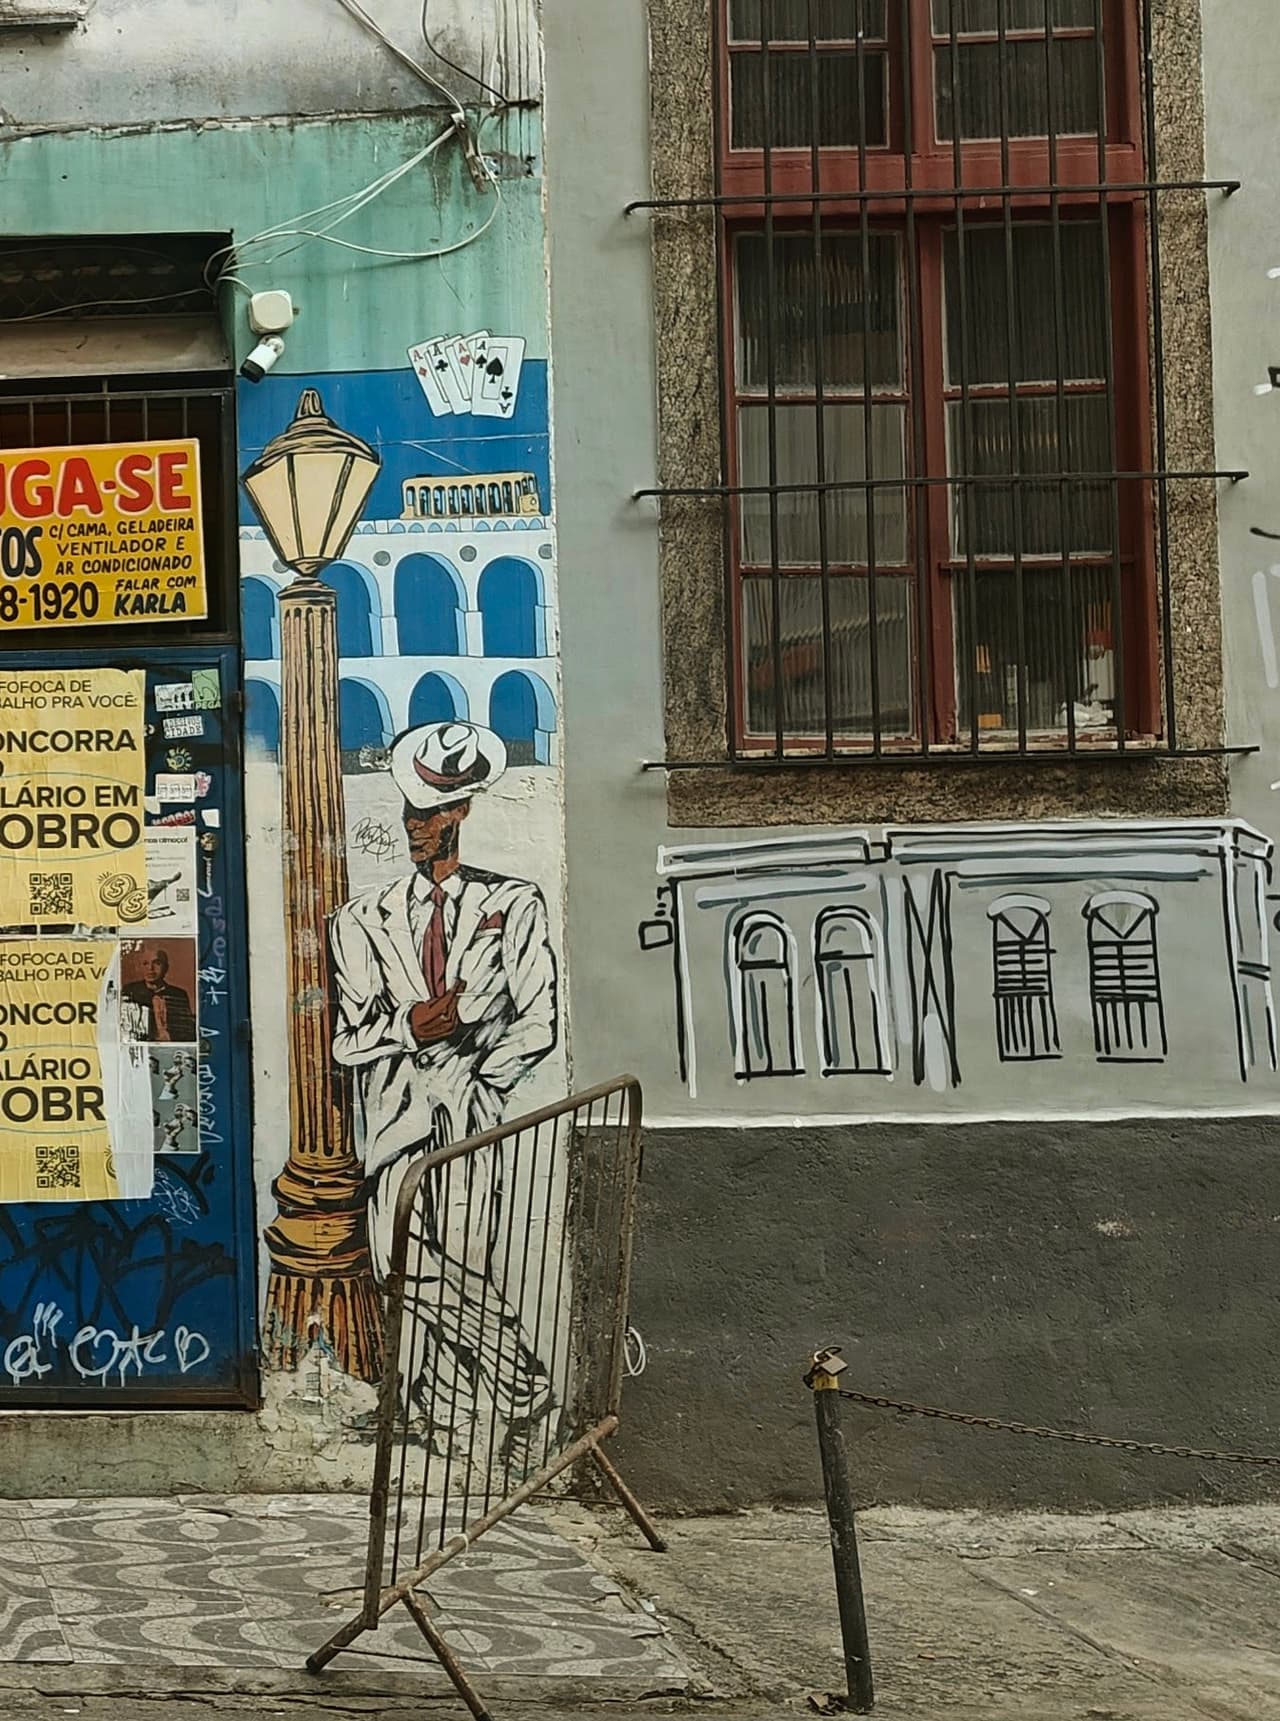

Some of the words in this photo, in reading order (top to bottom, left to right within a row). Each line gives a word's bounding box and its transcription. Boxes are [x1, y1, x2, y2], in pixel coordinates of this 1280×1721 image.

[49, 523, 64, 540] C/
[67, 523, 112, 538] CAMA,
[117, 518, 194, 535] GELADEIRA
[57, 537, 167, 556] VENTILADOR
[176, 536, 185, 550] E
[56, 562, 74, 575] AR
[82, 555, 192, 574] CONDICIONADO
[115, 578, 159, 591] FALAR
[166, 576, 196, 589] COM
[114, 592, 186, 616] KARLA
[70, 680, 92, 692] DE
[52, 696, 84, 708] PRA
[95, 786, 138, 807] EM
[0, 952, 67, 966] FOFOCA
[72, 952, 94, 965] DE
[55, 968, 87, 980] PRA
